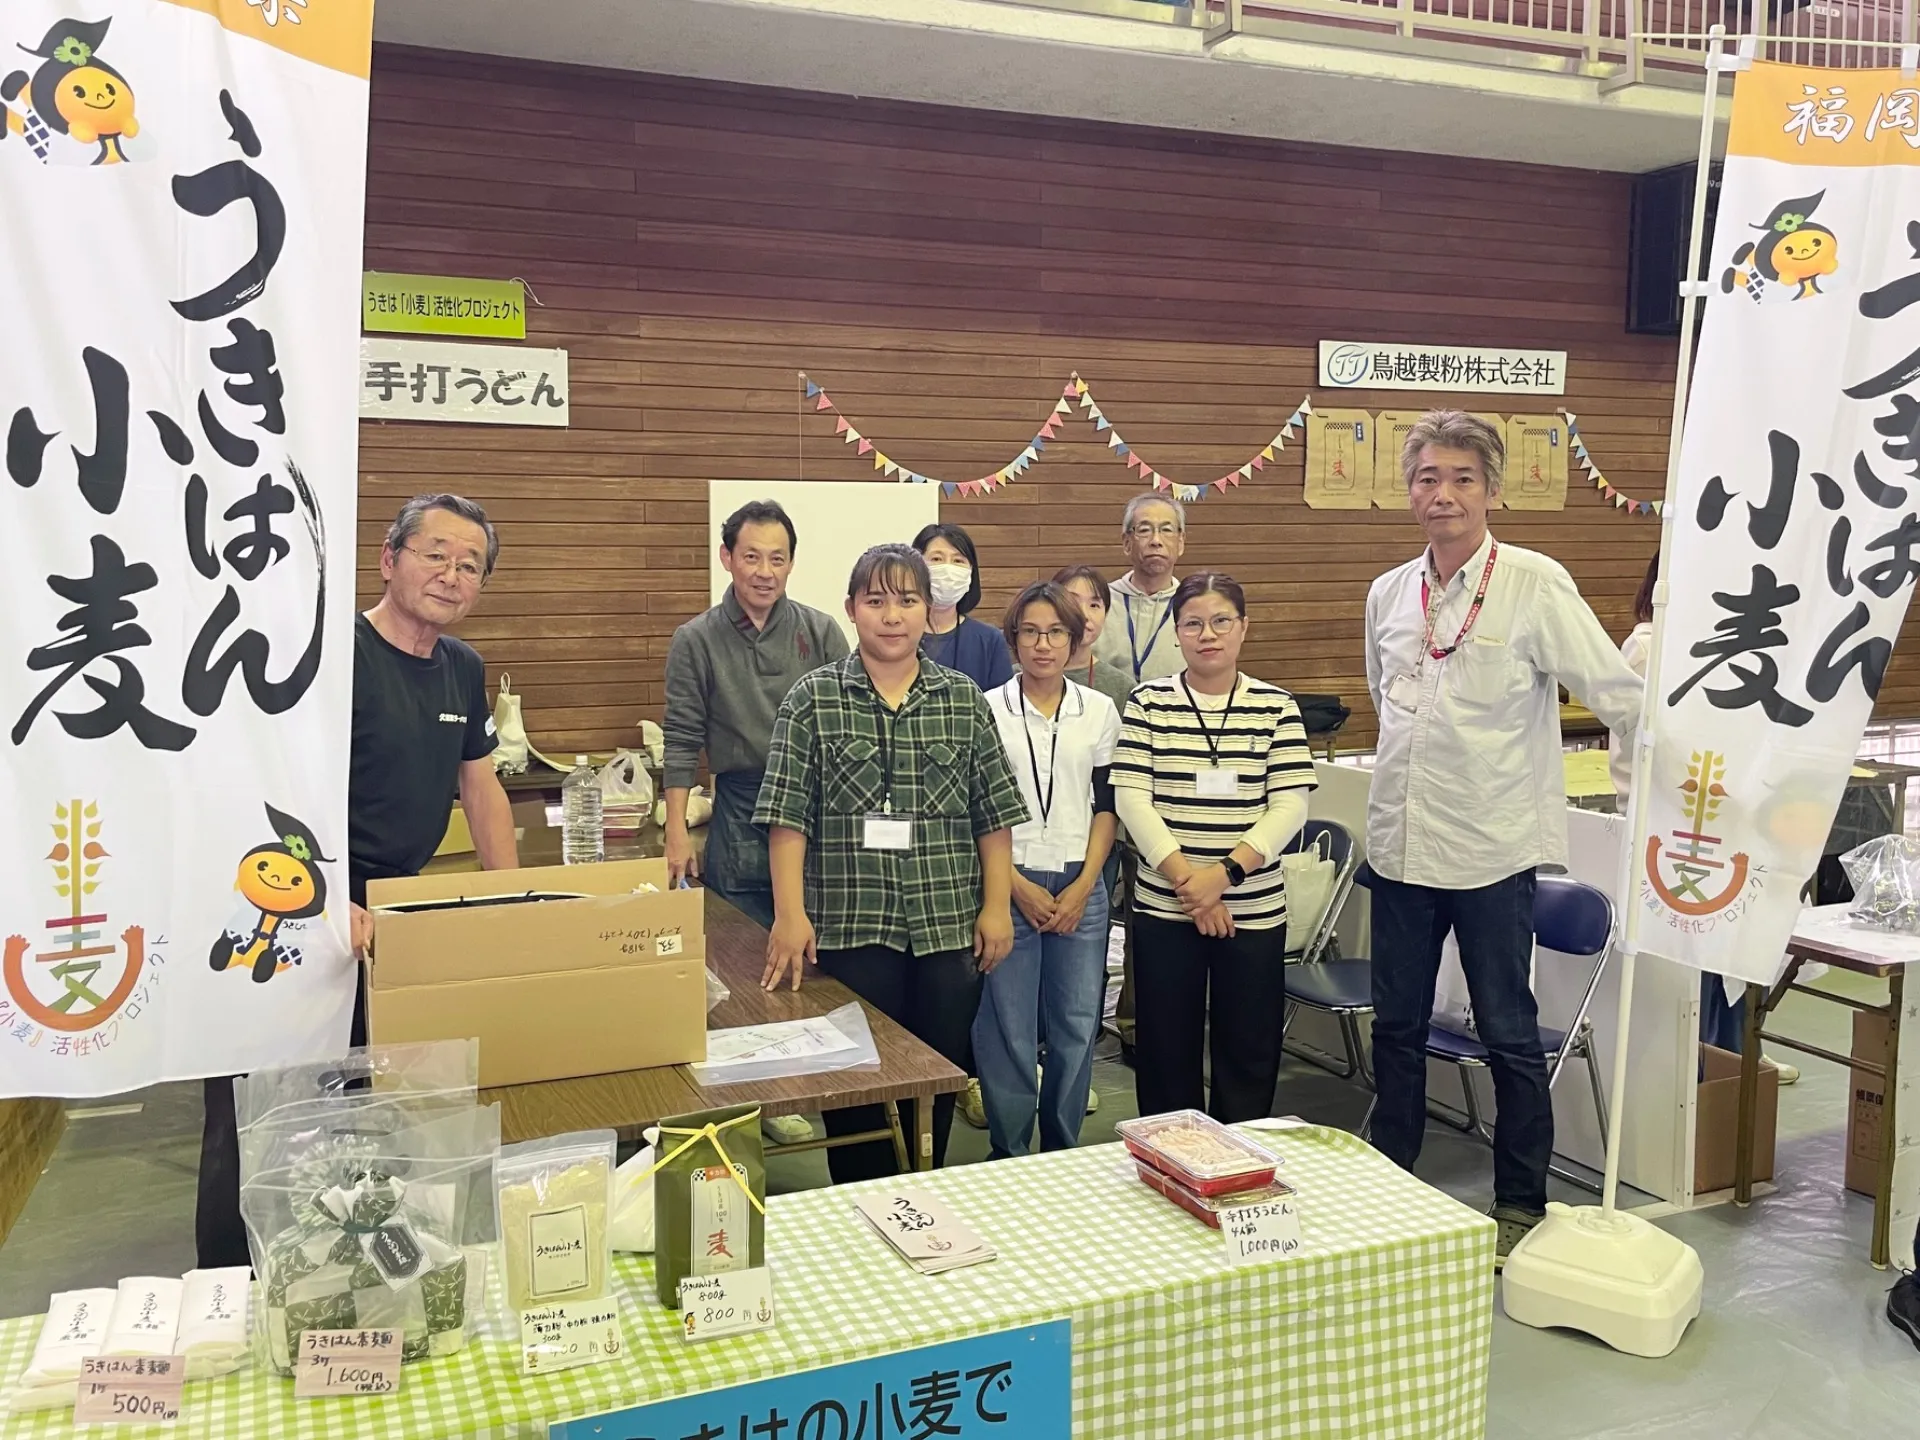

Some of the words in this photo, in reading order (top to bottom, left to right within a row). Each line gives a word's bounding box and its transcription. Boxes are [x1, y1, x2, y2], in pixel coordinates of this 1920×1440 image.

[367, 291, 521, 321] うきは「小麦」活性化プロジェクト
[365, 361, 565, 408] 手打うどん
[1369, 351, 1556, 387] 鳥越製粉株式会社
[168, 88, 326, 716] うきはん
[6, 346, 197, 752] 小麦
[1668, 429, 1845, 728] 小麦
[706, 1228, 734, 1258] 麦
[703, 1307, 735, 1324] 800
